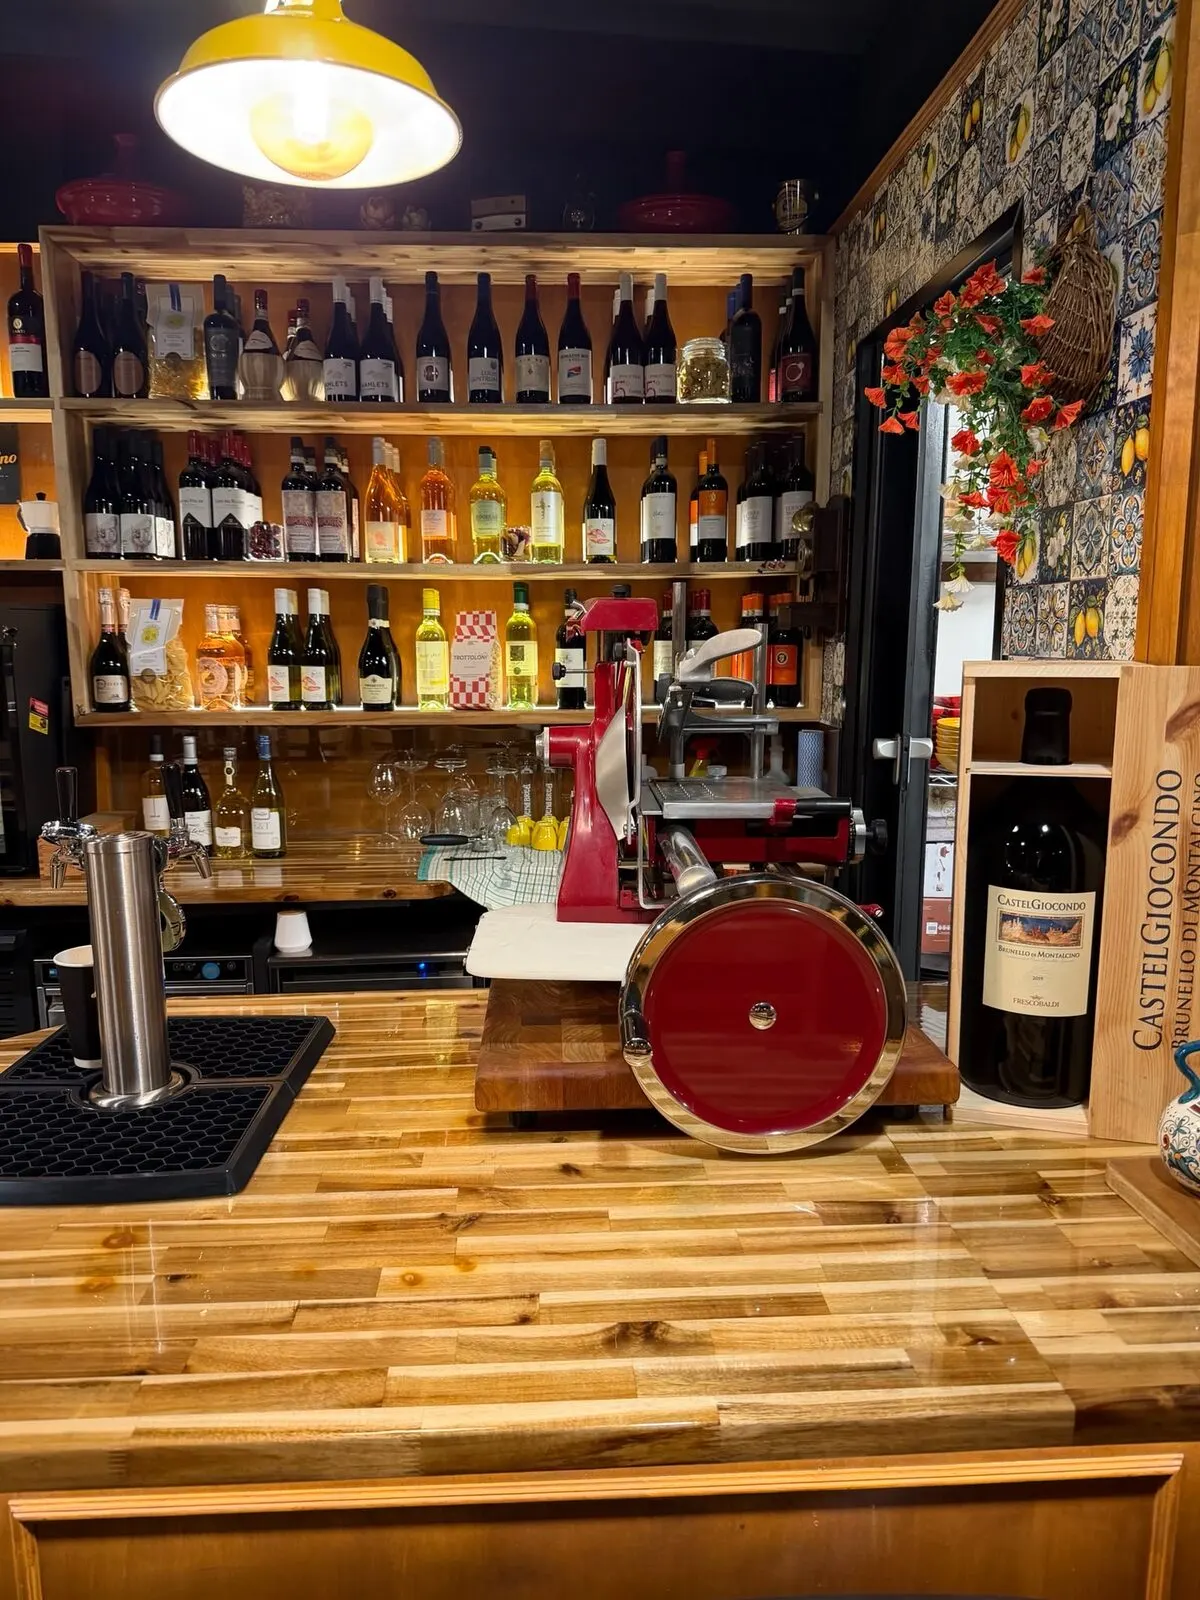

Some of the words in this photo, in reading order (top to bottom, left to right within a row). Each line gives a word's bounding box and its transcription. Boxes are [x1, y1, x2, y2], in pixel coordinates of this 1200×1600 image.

[0, 453, 18, 465] no
[997, 894, 1086, 911] CASTELGIOCONDO
[1132, 769, 1183, 1051] CASTELGIOCONDO
[1182, 920, 1199, 942] DI
[998, 944, 1031, 957] BRUNELLO
[1037, 951, 1080, 959] MONTALCINO
[1013, 997, 1060, 1008] FRESCOBALDI
[1171, 949, 1197, 1049] BRUNELLO
